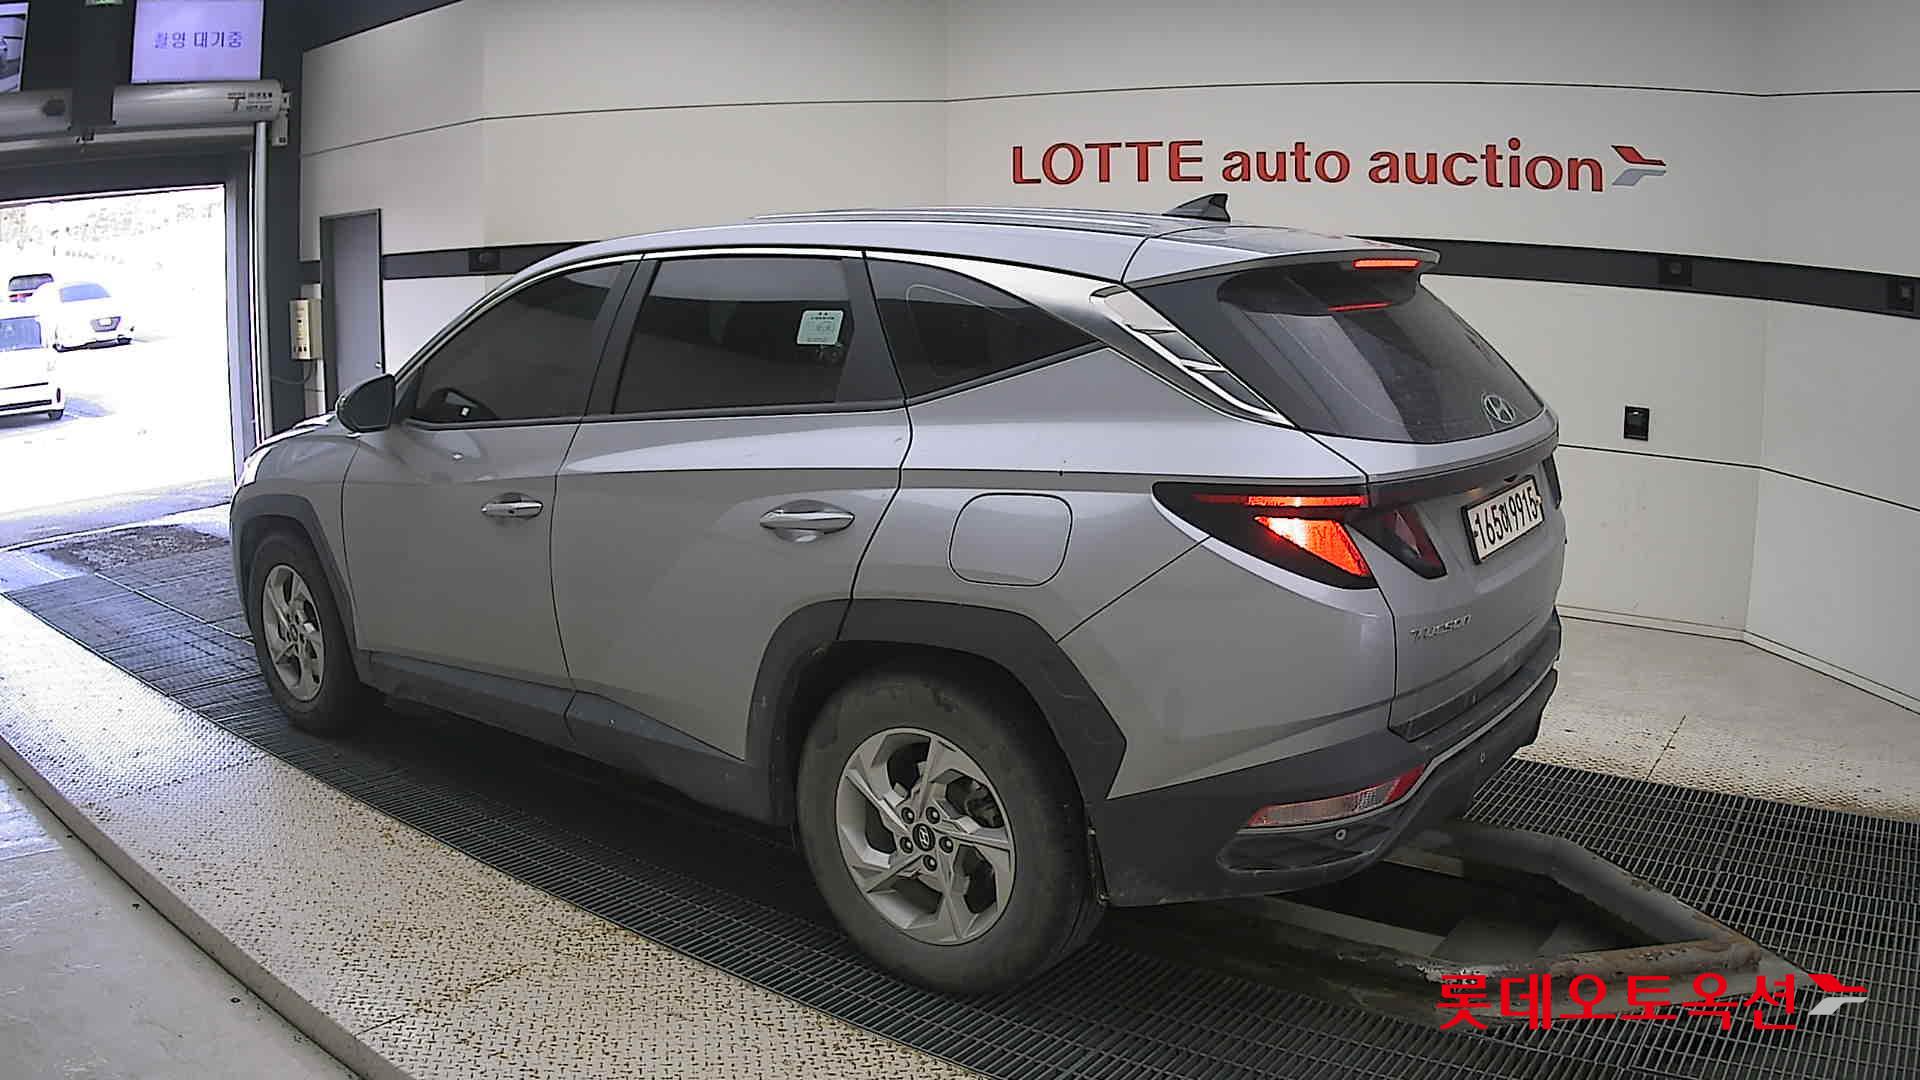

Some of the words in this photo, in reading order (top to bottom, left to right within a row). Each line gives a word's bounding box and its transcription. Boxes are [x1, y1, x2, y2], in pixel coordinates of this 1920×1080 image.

[193, 31, 243, 49] 대기중
[1012, 140, 1204, 185] LOTTE
[1221, 141, 1351, 184] auto
[1368, 137, 1604, 192] auction
